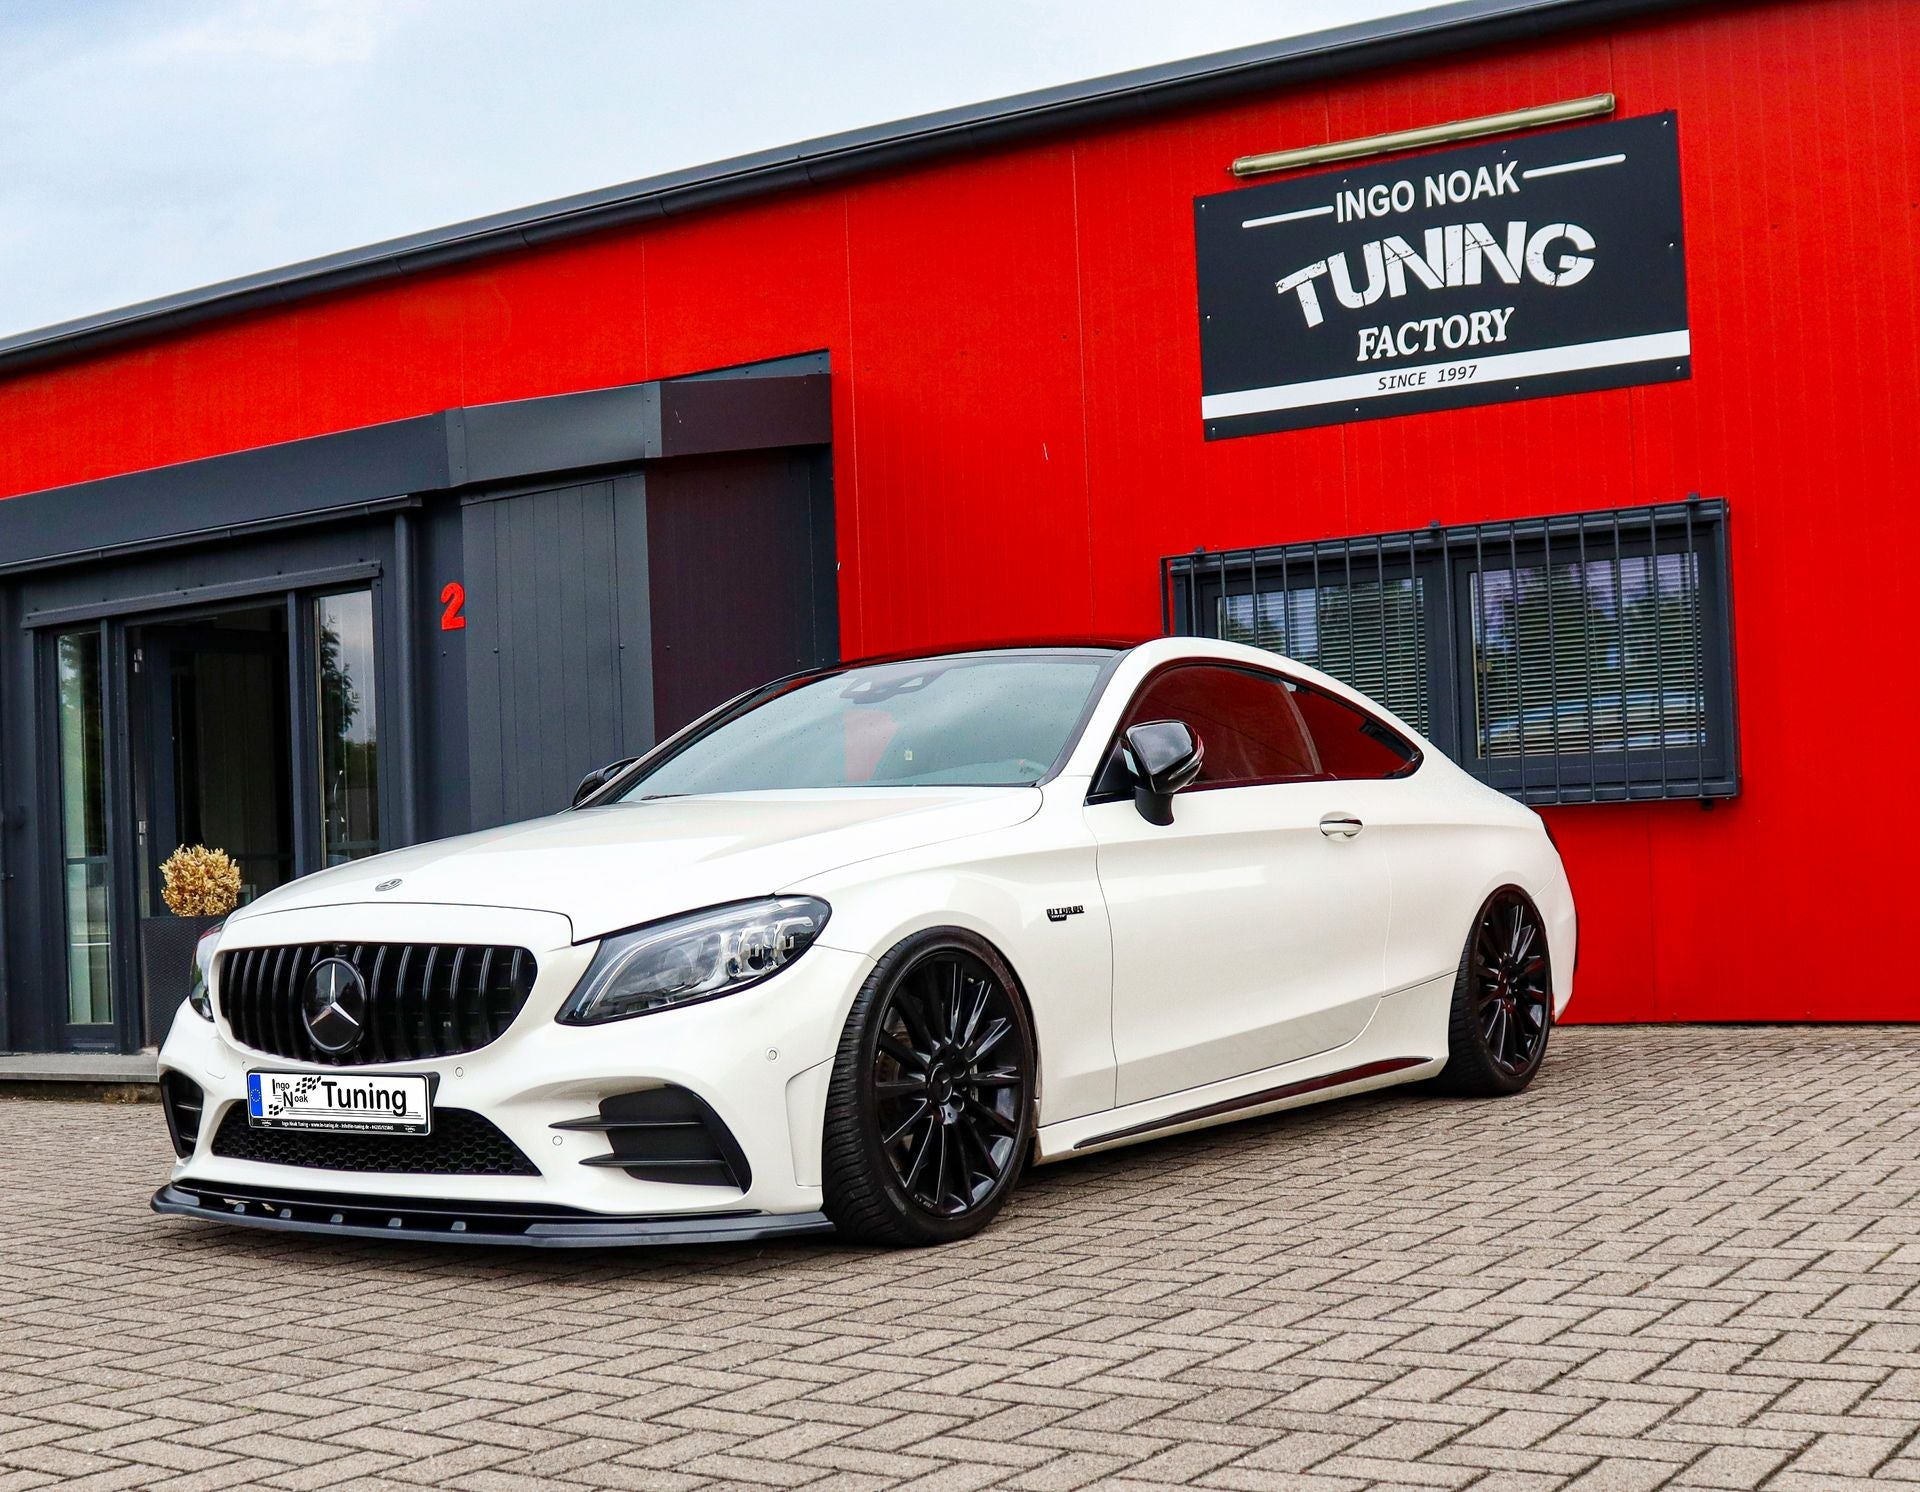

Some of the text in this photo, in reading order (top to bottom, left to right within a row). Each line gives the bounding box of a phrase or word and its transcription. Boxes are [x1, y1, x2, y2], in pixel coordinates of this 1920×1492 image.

[1336, 160, 1520, 223] INGO NOAK
[1275, 221, 1596, 328] TUNING
[1356, 306, 1515, 362] FACTORY
[1378, 365, 1477, 391] SINCE 1997
[440, 581, 465, 631] 2
[272, 1078, 290, 1094] Ingo
[283, 1091, 308, 1107] Noak
[321, 1081, 406, 1117] Tuning
